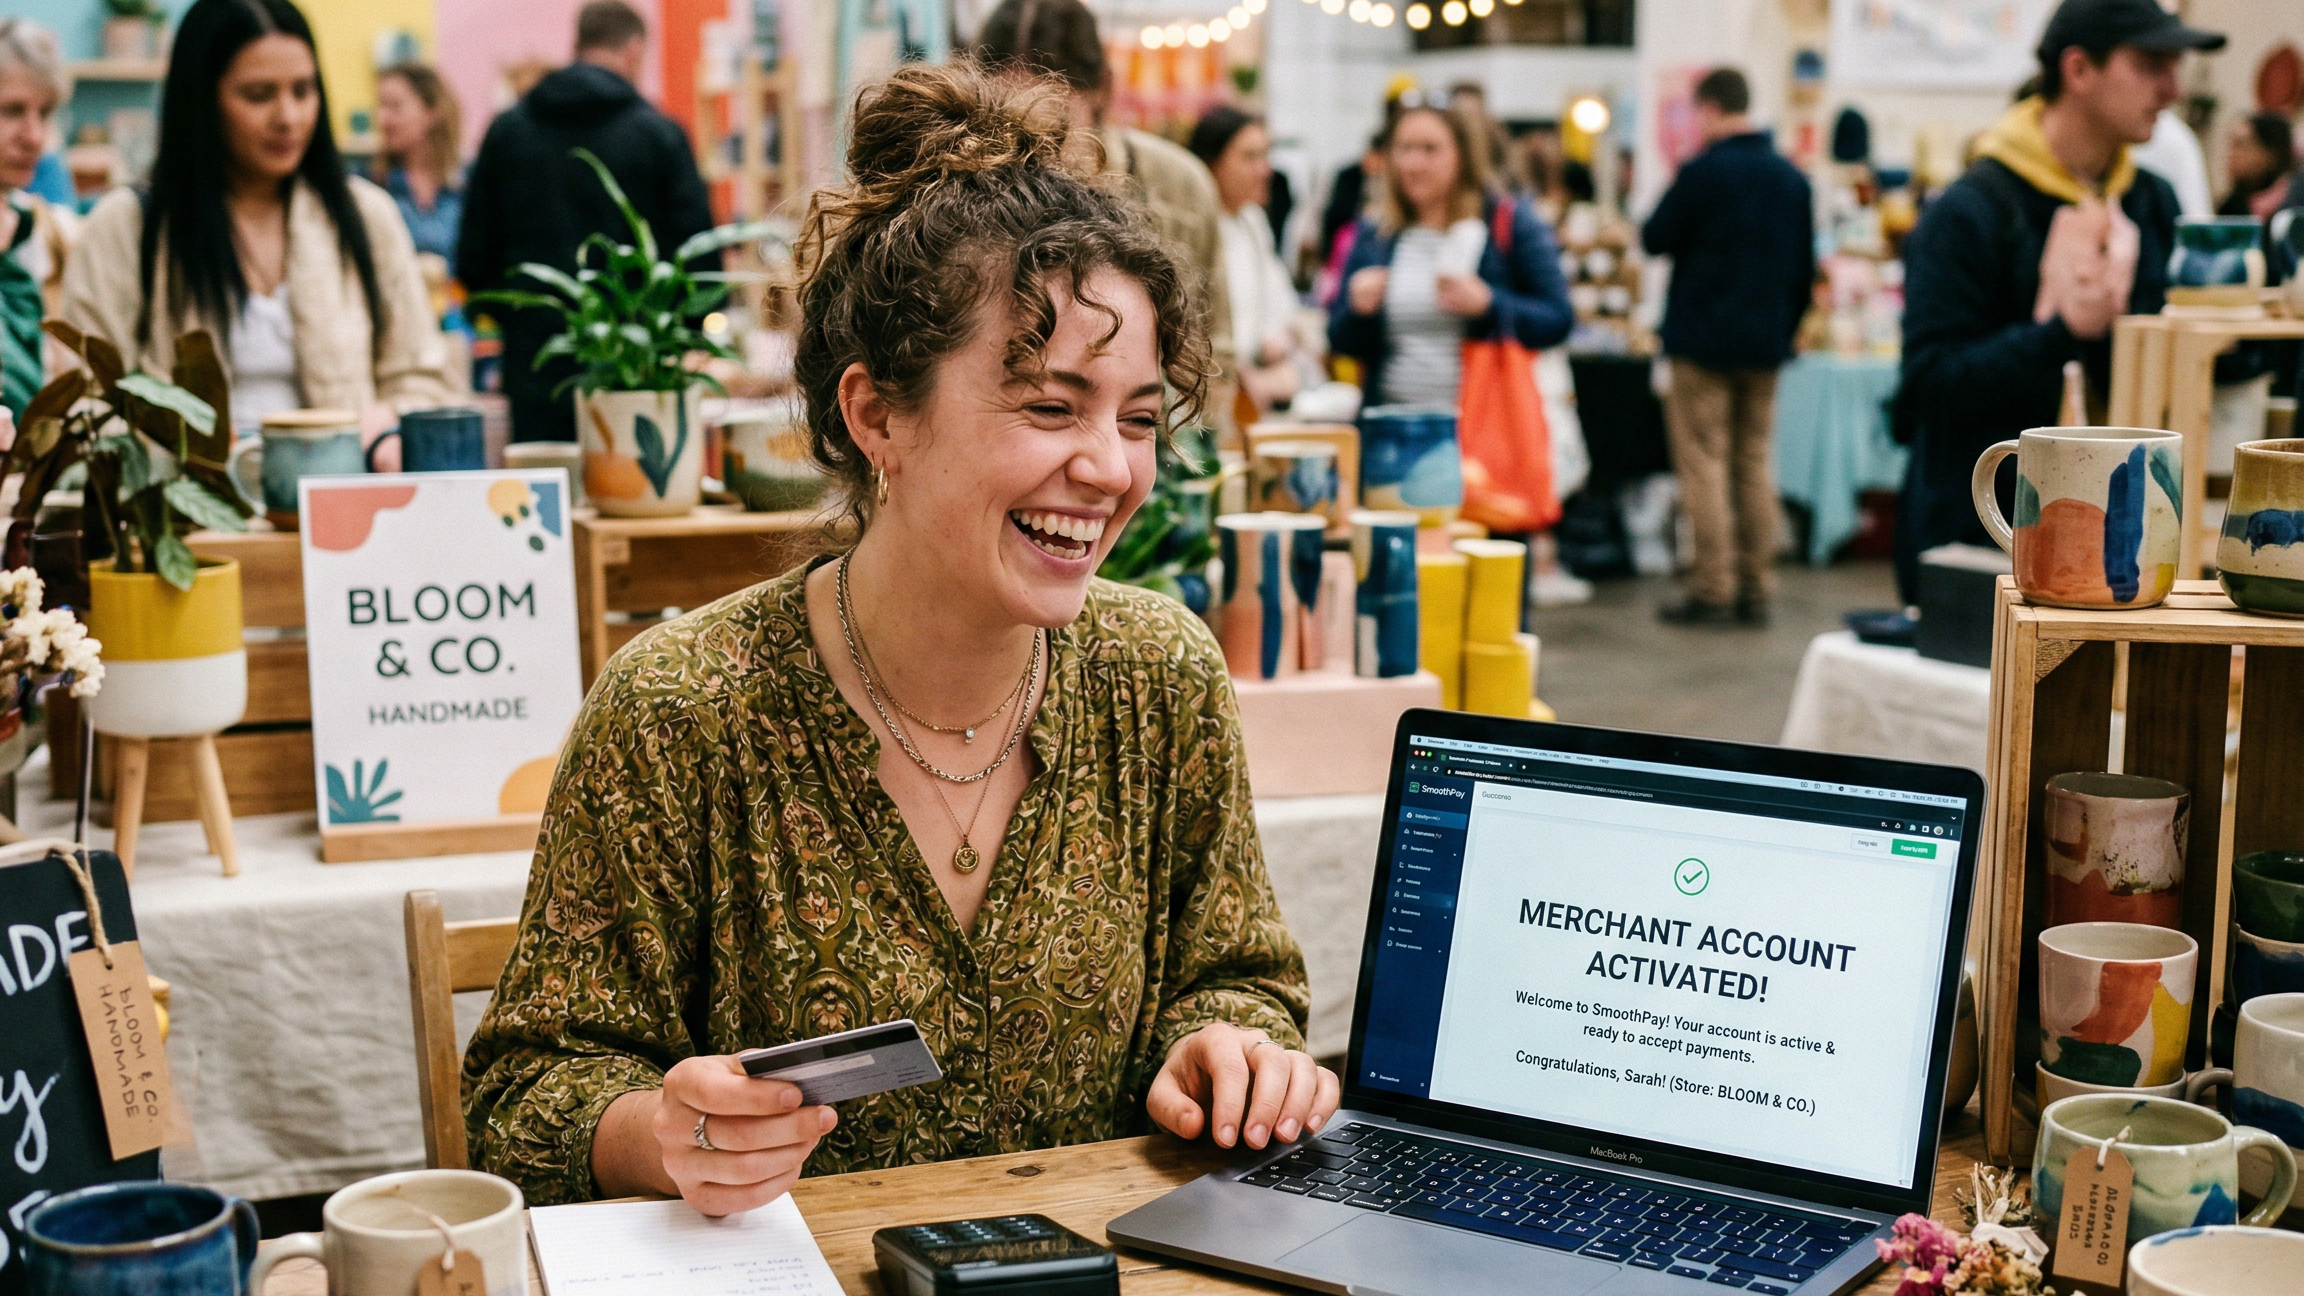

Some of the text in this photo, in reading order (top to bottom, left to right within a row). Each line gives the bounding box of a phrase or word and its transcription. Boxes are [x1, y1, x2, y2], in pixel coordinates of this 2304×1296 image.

[348, 581, 536, 625] BLOOM
[376, 636, 516, 678] & CO.
[368, 698, 529, 726] HANDMADE
[1421, 784, 1466, 799] SmoothPay
[0, 911, 89, 996] DE
[1519, 898, 1857, 972] MERCHANT ACCOUNT
[1585, 950, 1769, 1003] ACTIVATED!
[1516, 990, 1836, 1055] Welcome to SmoothPay! Your account is active &
[1583, 1025, 1755, 1064] ready to accept payments.
[98, 984, 140, 1119] HANDMADE
[1516, 1050, 1816, 1117] Congratulations, Sarah! (Store: BLOOM & CO.)
